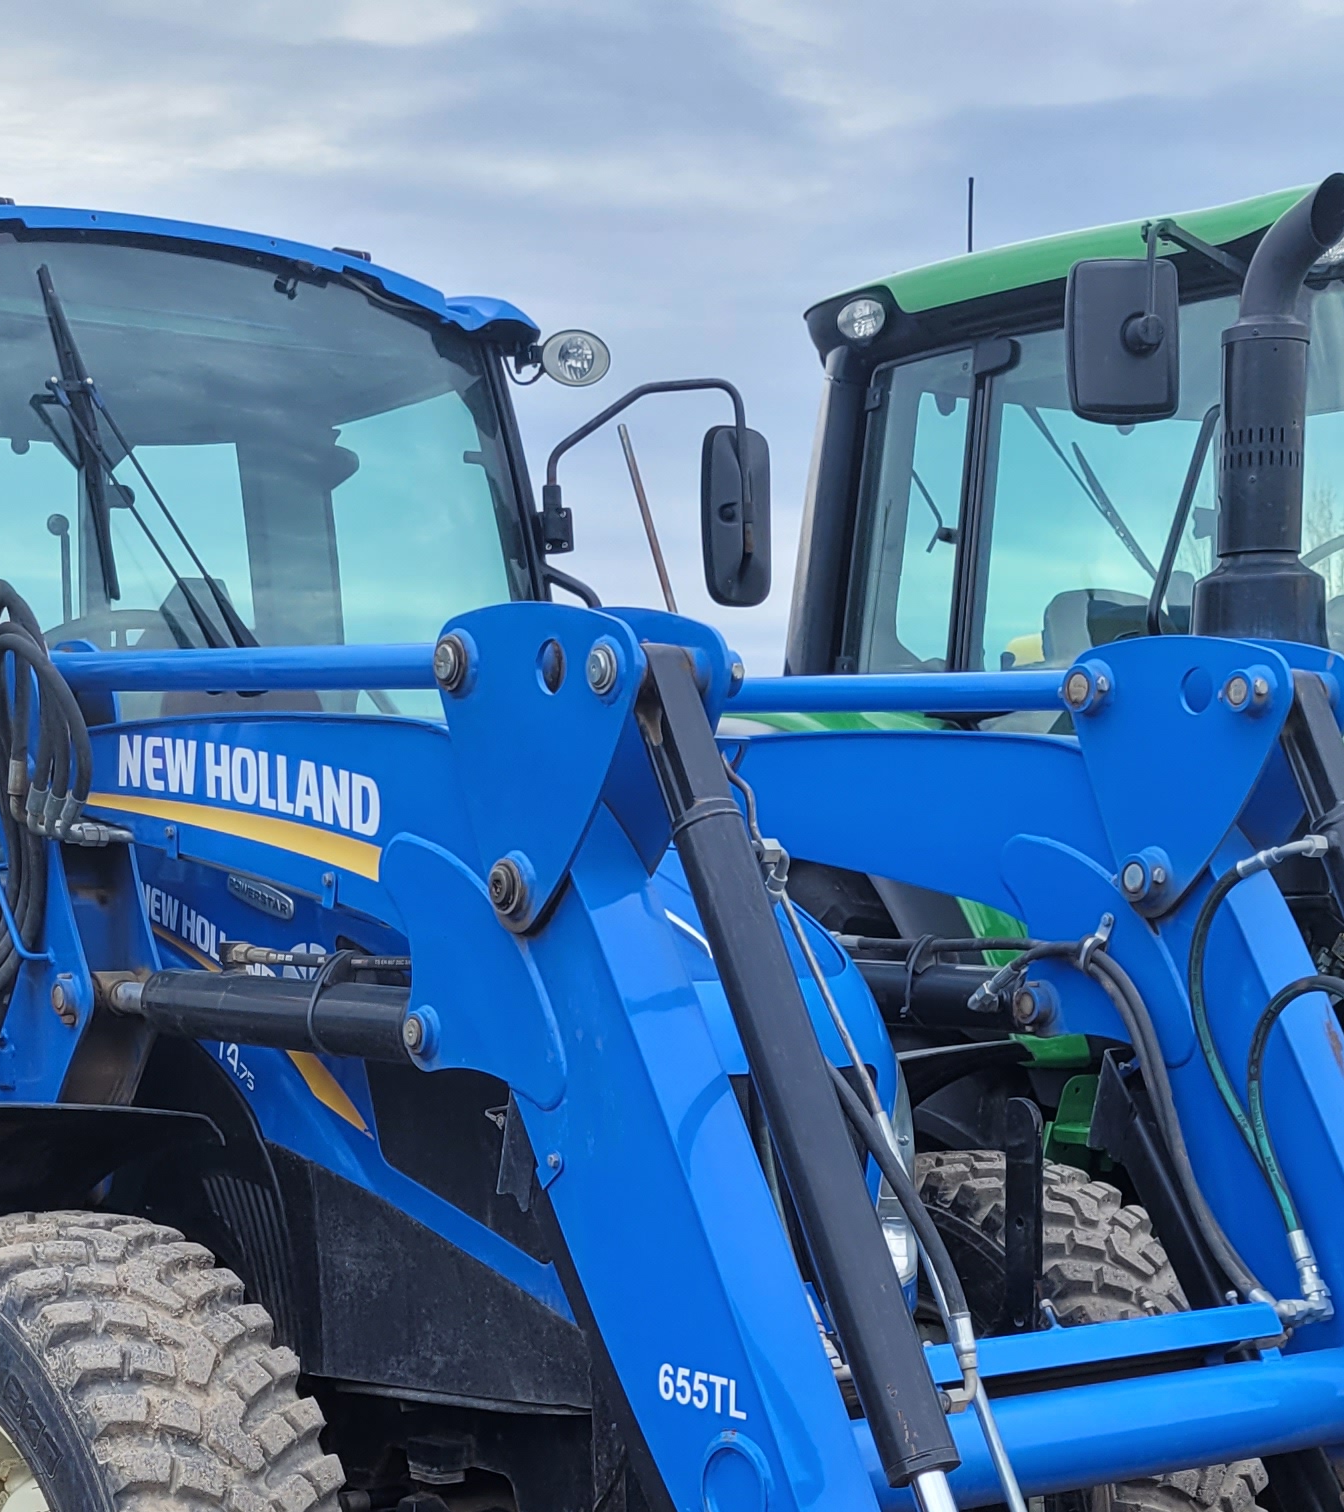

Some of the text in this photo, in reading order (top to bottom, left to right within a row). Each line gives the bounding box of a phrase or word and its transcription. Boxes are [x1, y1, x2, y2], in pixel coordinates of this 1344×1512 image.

[118, 735, 381, 837] NEW HOLLAND
[230, 876, 289, 914] POWERSTAR
[659, 1363, 747, 1420] 655TL
